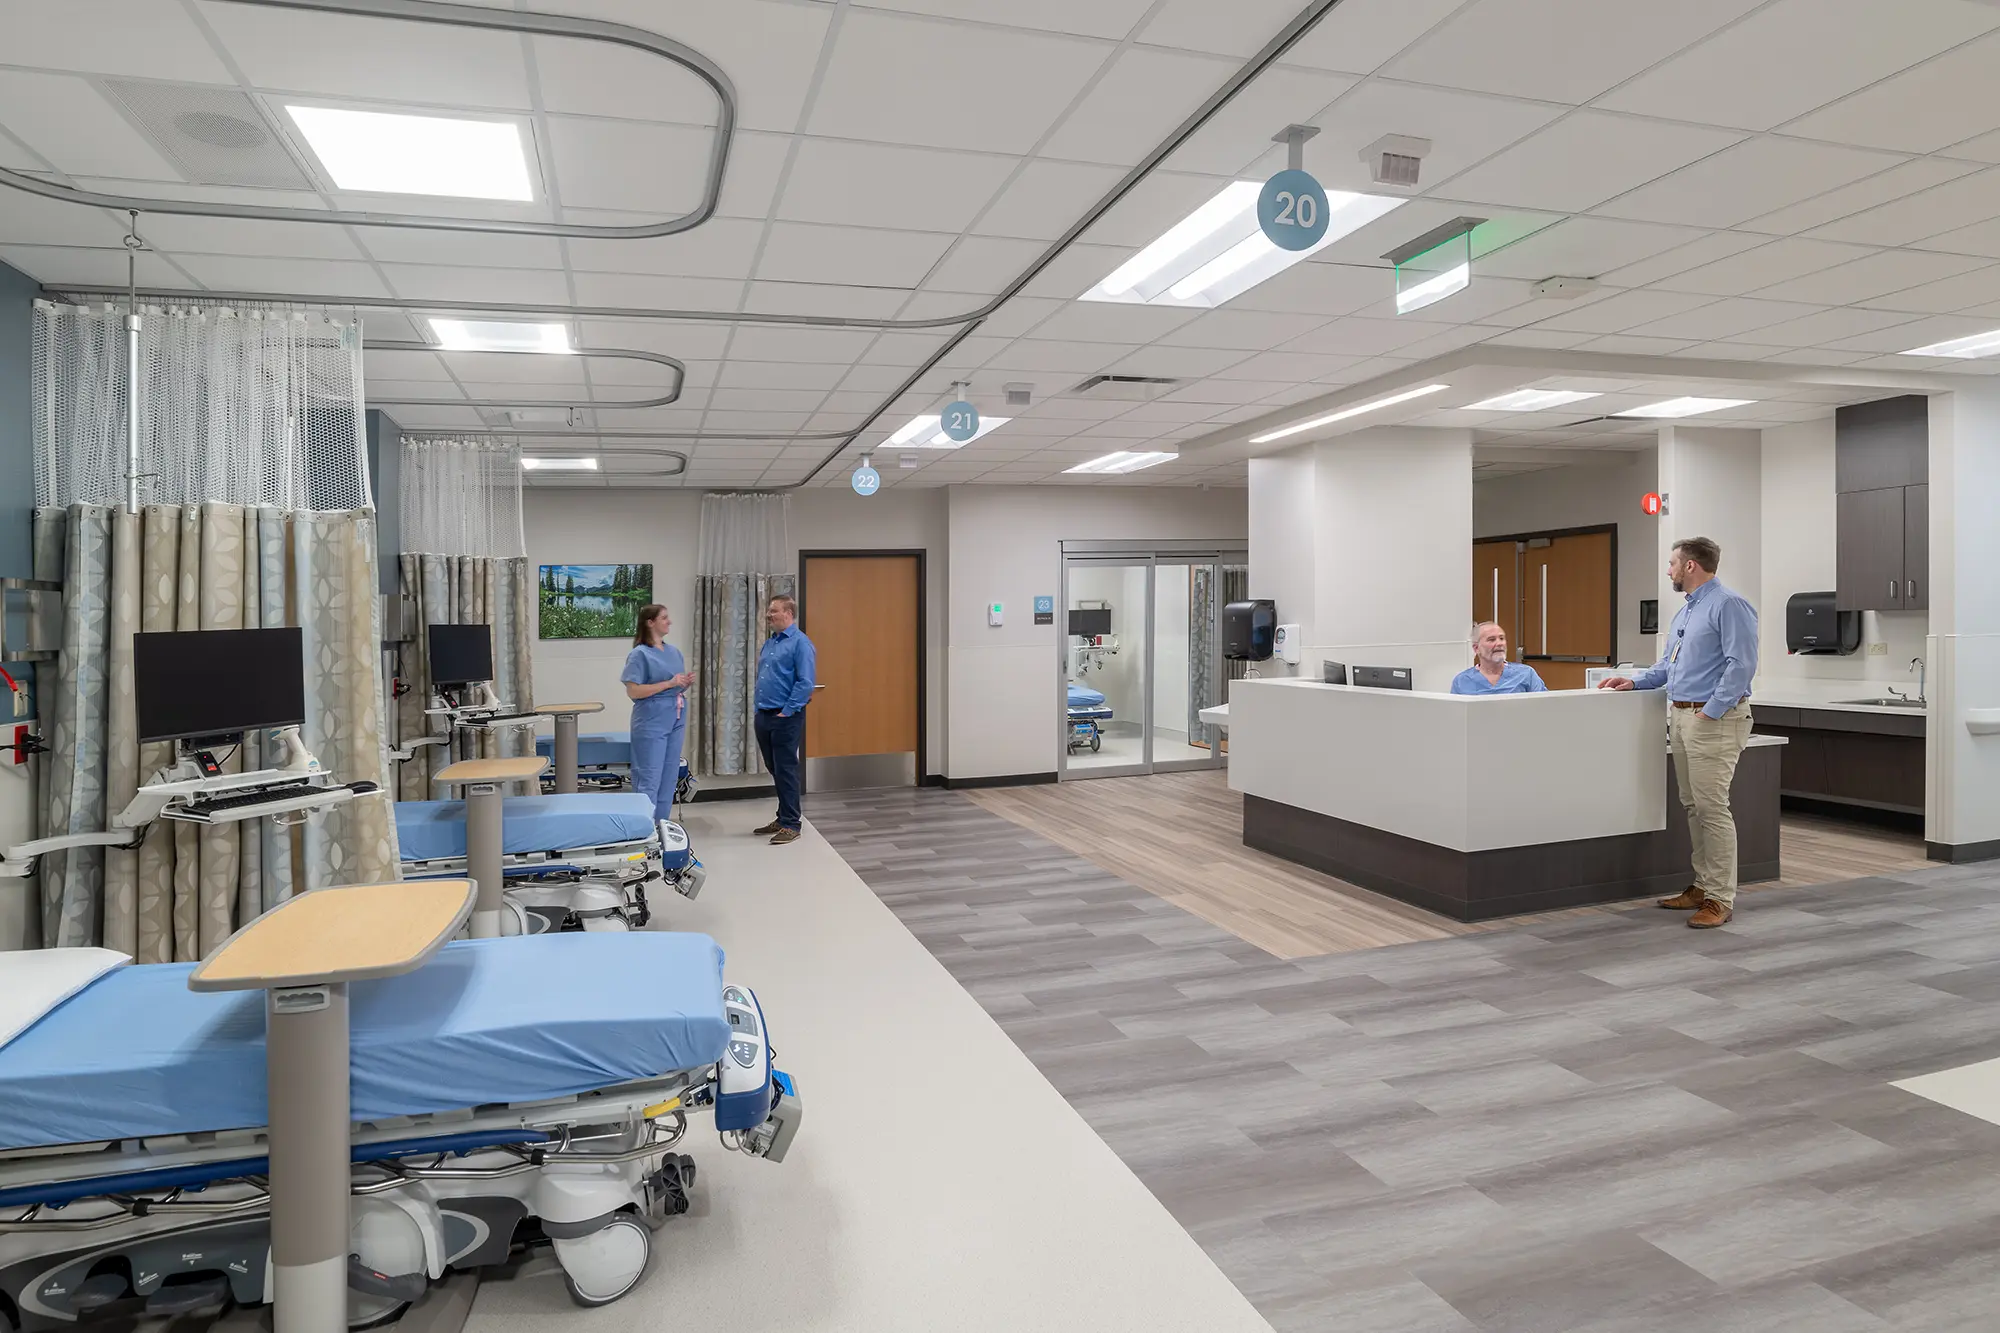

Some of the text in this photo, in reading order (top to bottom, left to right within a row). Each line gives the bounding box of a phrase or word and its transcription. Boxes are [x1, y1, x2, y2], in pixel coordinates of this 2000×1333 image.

[1275, 192, 1316, 228] 20
[950, 412, 971, 430] 21
[857, 475, 875, 488] 22
[1038, 600, 1050, 609] 23
